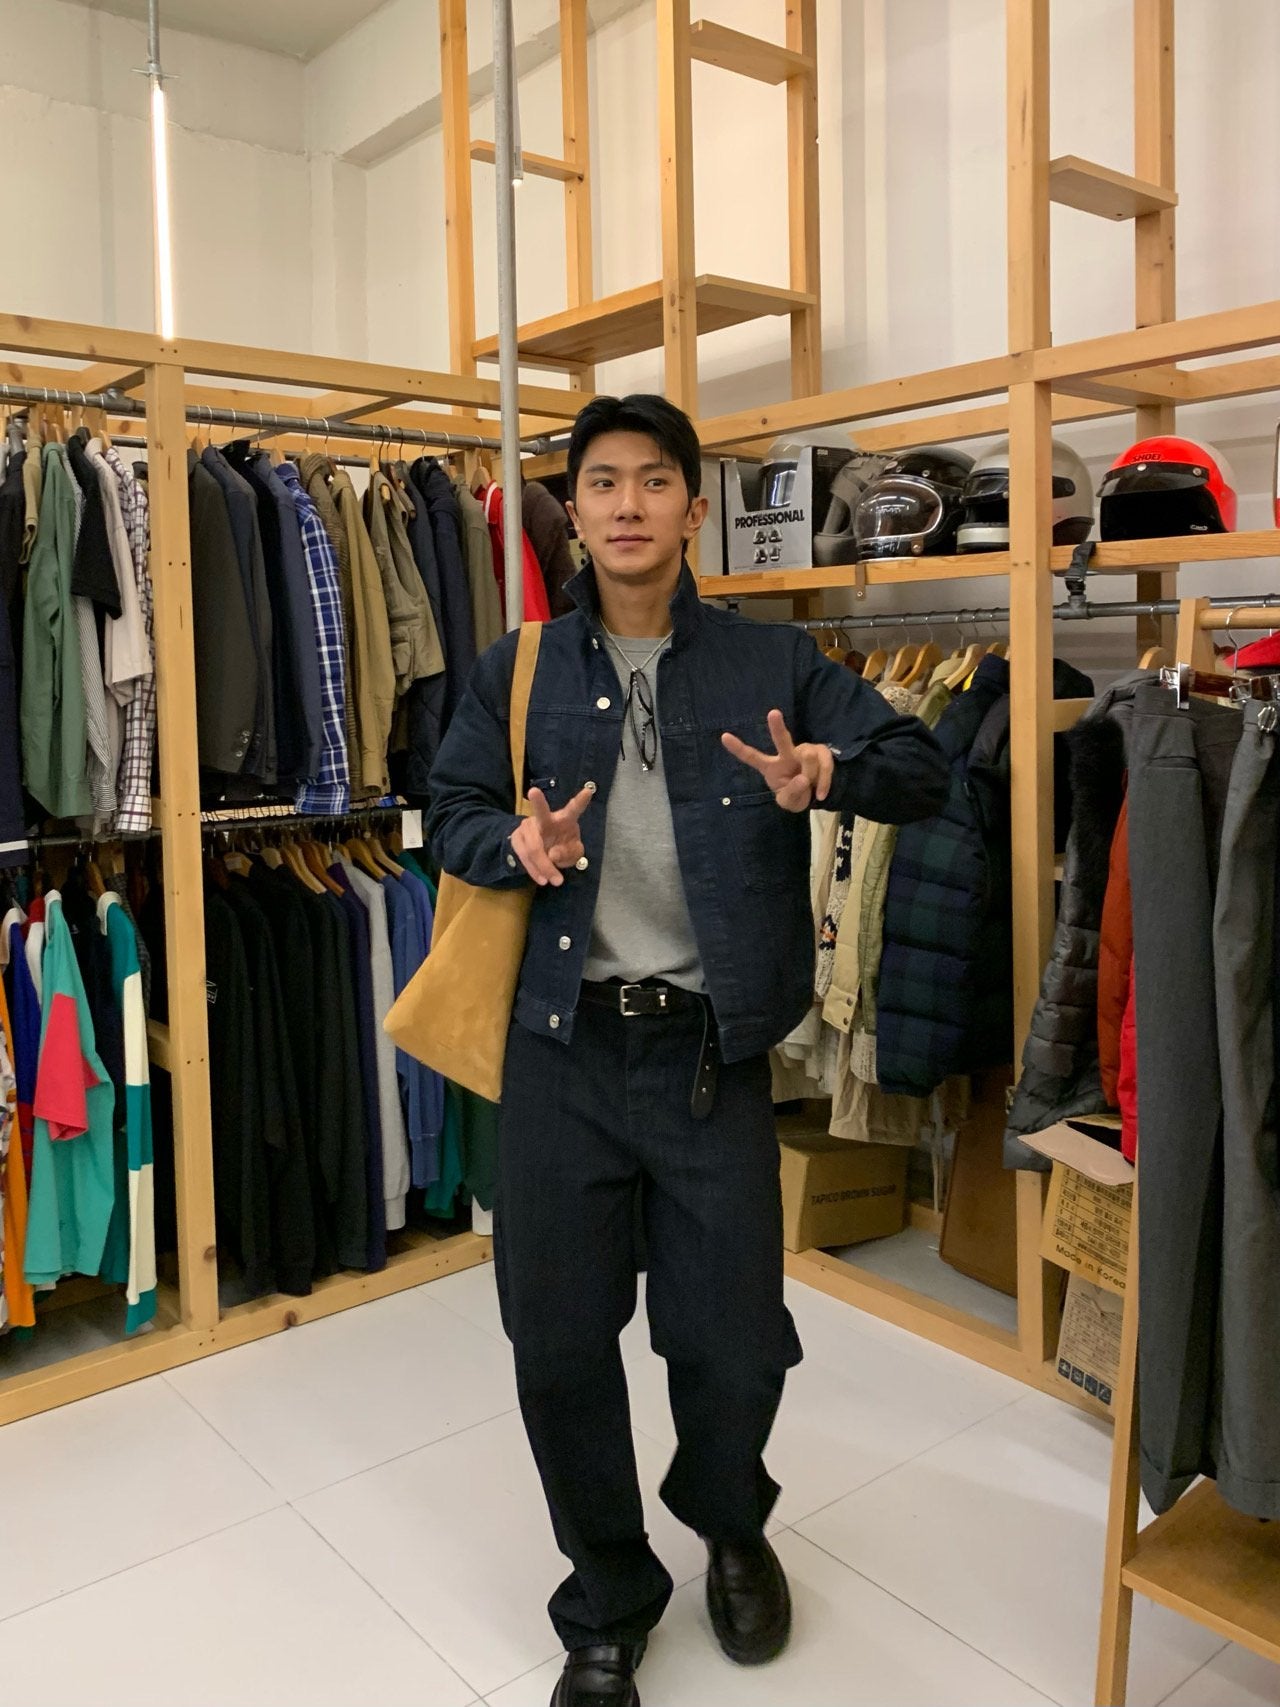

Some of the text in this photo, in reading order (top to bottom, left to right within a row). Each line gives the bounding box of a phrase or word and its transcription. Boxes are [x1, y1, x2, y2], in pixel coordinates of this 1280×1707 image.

[1132, 453, 1161, 462] SHOEI
[735, 509, 805, 529] PROFESSIONAL
[1055, 1244, 1127, 1290] Made in Korea
